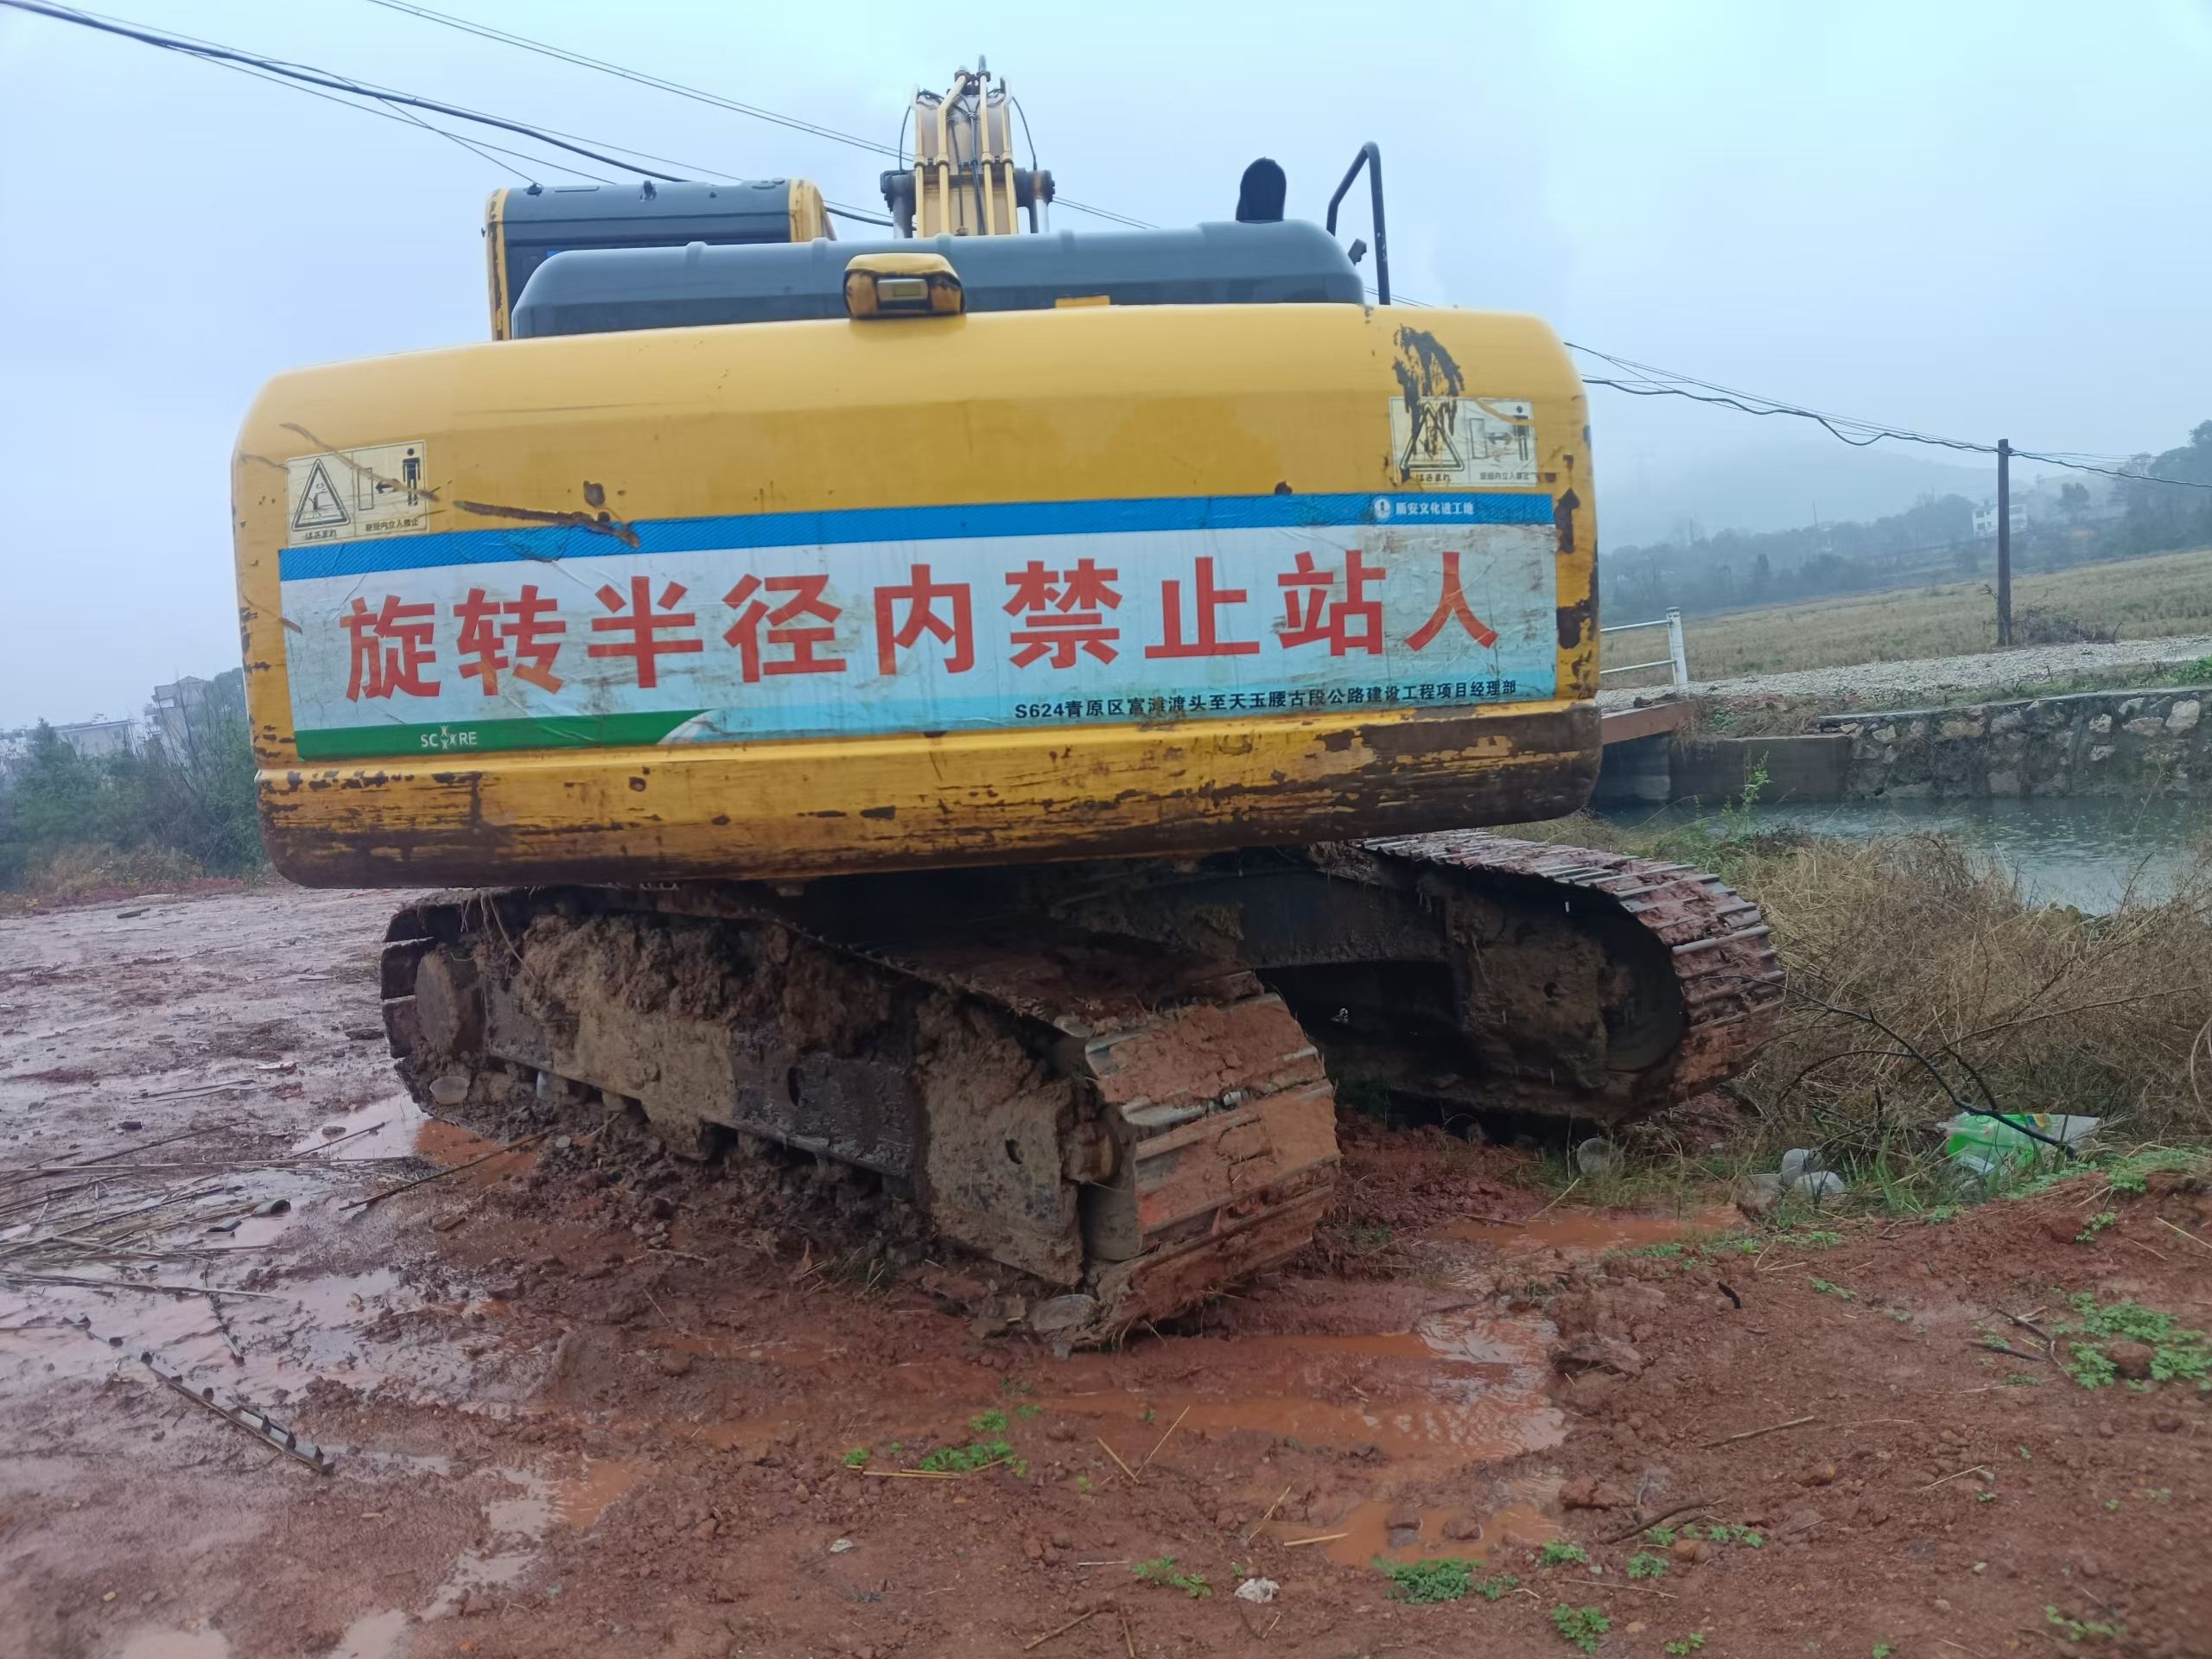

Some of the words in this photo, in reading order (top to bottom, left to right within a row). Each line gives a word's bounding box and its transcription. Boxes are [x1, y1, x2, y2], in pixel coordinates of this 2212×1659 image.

[340, 549, 1499, 702] 旋转半径内禁止站人
